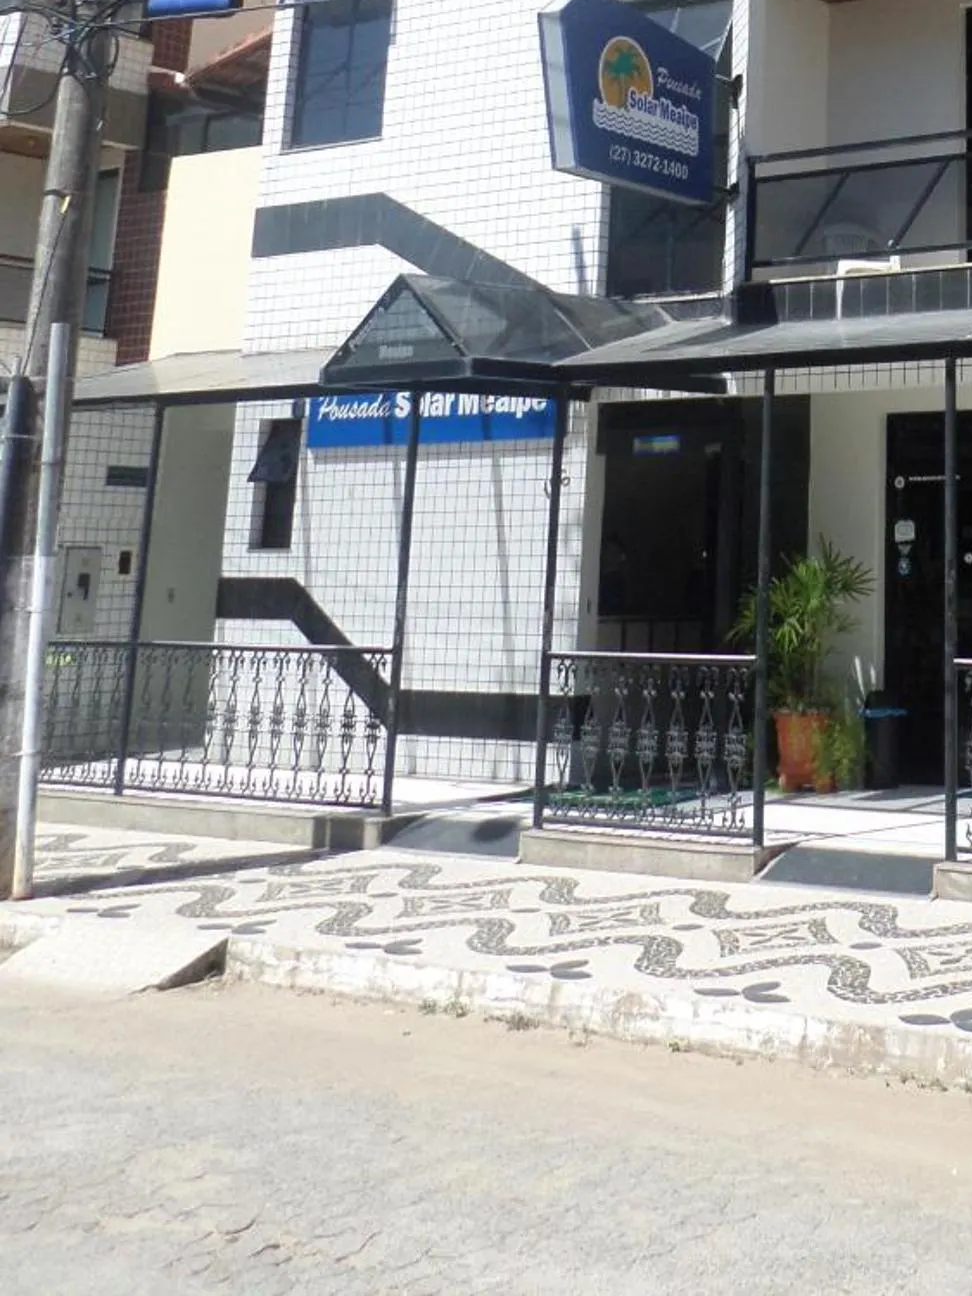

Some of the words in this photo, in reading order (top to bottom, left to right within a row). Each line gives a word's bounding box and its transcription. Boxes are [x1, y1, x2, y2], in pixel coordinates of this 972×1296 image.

[630, 88, 658, 115] Solar
[609, 144, 631, 165] (27)
[633, 150, 688, 179] 3272-1400
[317, 395, 389, 422] Pousada
[394, 392, 455, 418] Slar
